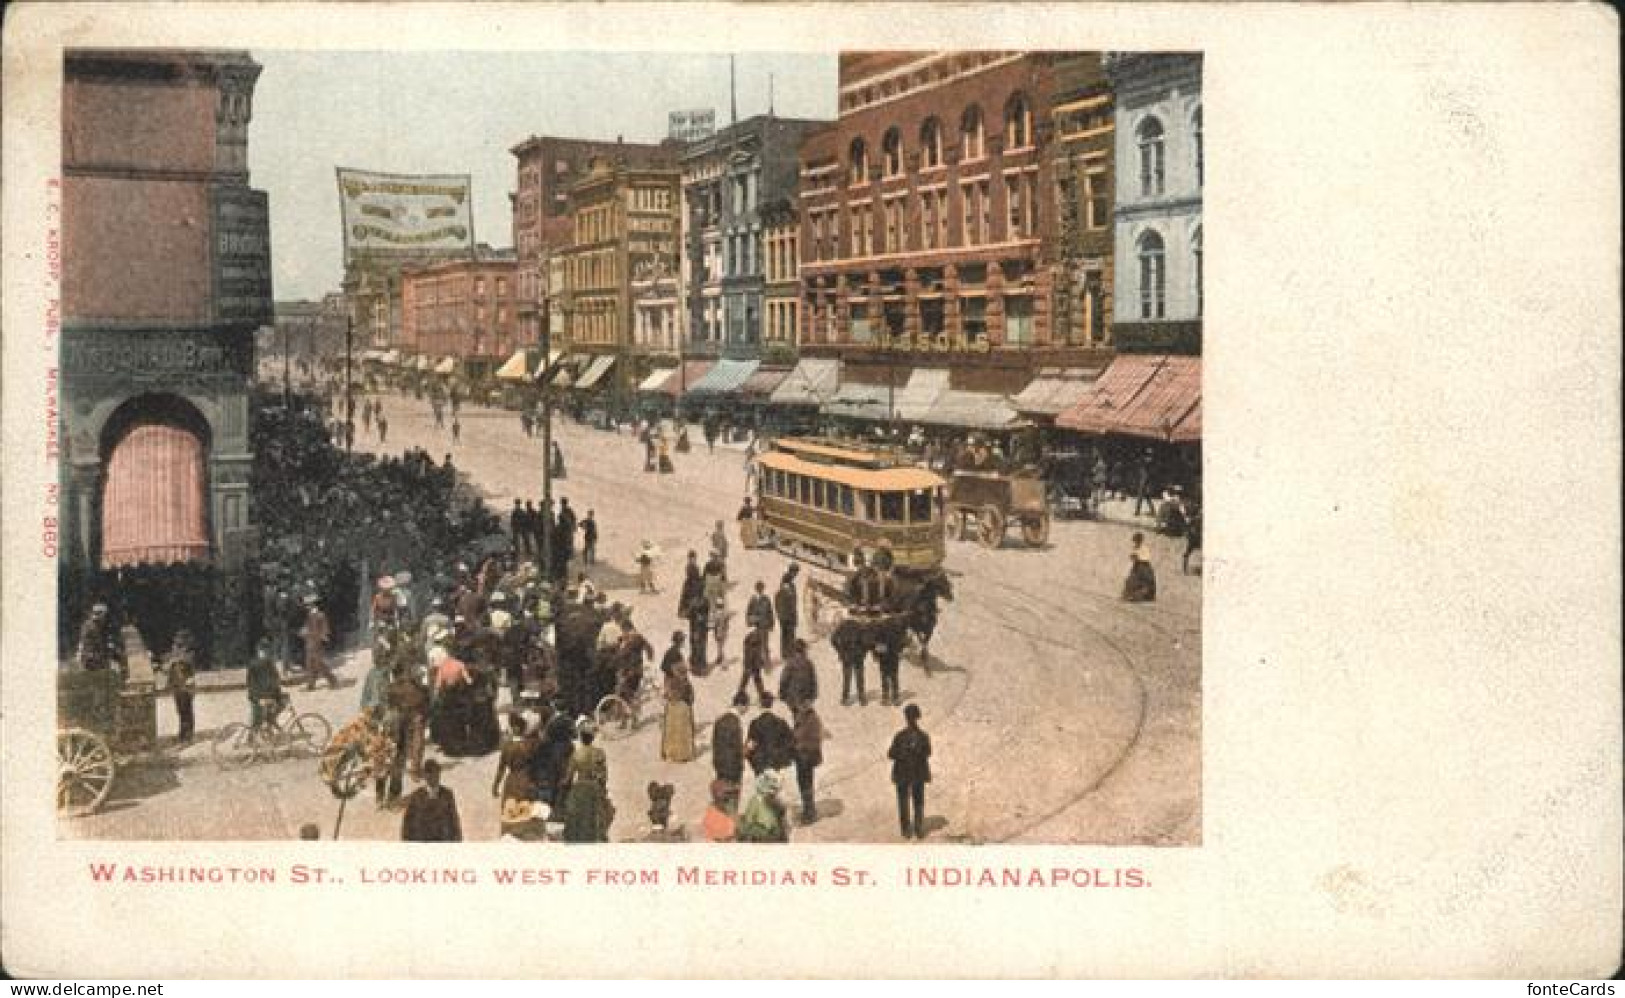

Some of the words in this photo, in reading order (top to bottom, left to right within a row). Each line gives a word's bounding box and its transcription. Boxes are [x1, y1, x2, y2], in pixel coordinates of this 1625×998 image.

[89, 863, 276, 883] WASHINGTON
[360, 868, 478, 884] LOOKING
[493, 868, 571, 884] WEST
[587, 868, 660, 885] FROM
[677, 866, 819, 886] MERIDIAN
[832, 867, 877, 887] ST.
[905, 867, 1153, 888] INDIANAPOLIS.
